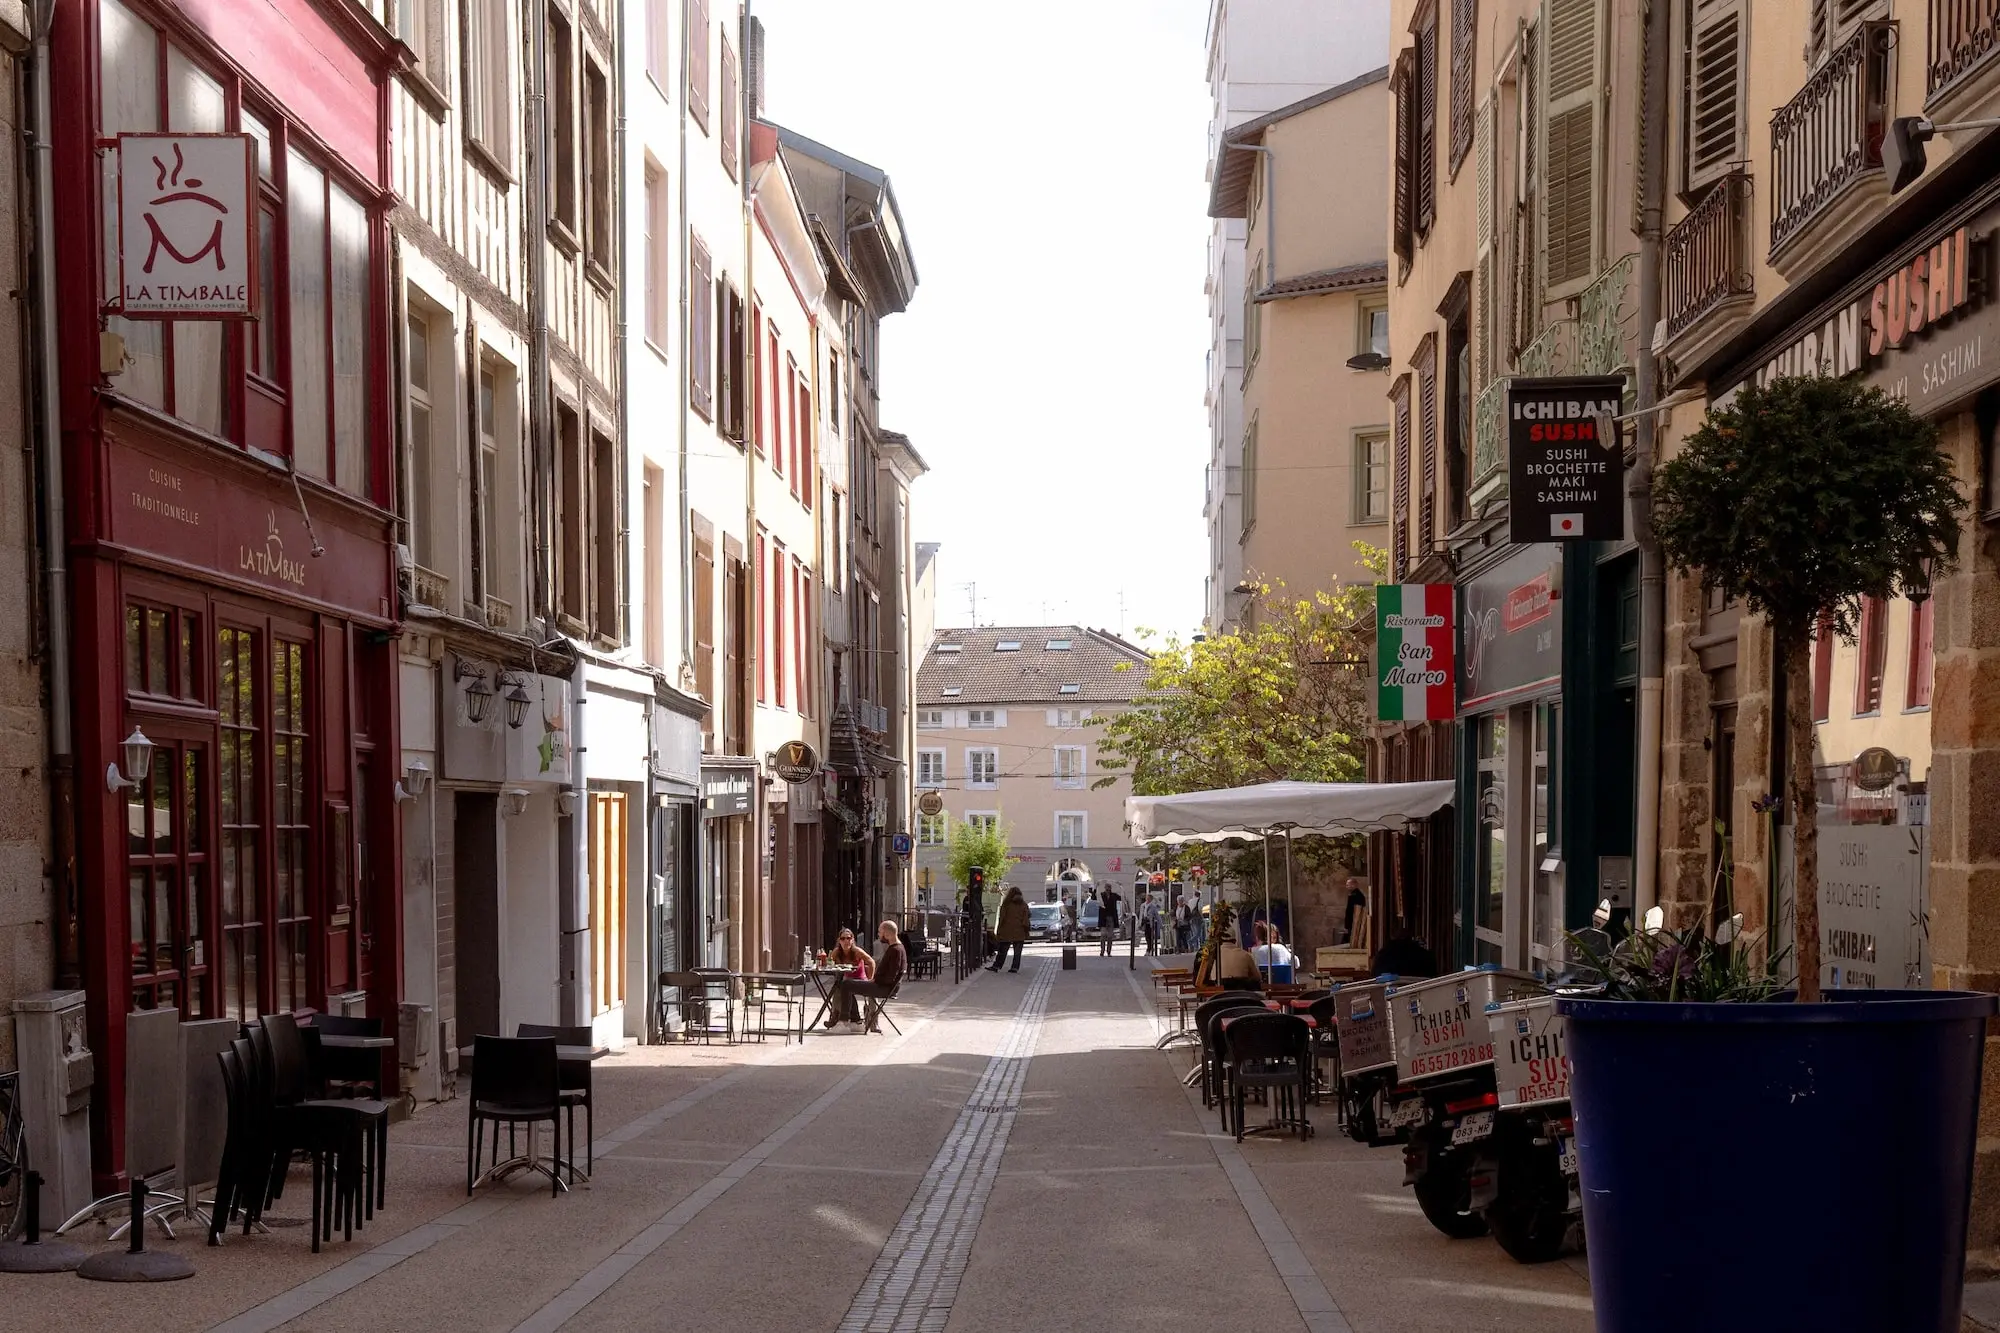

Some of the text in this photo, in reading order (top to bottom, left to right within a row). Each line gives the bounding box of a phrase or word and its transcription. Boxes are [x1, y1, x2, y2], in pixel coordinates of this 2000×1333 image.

[126, 285, 246, 300] LA TIMBALE
[1869, 227, 1970, 356] SUSHI
[1922, 335, 1982, 395] SASHIMI
[1513, 400, 1619, 420] ICHIBAN
[1530, 423, 1600, 442] SUSH
[1546, 449, 1588, 461] SUSHI
[1526, 462, 1607, 475] BROCHETTE
[149, 468, 183, 492] CUISINE
[1549, 476, 1585, 488] MAKI
[1537, 490, 1598, 503] SASHIMI
[131, 492, 200, 526] TRADITIONNELLE
[240, 543, 306, 586] LA TIMBALE
[1385, 614, 1445, 628] Ristorante
[1399, 643, 1432, 660] San
[1383, 667, 1446, 686] Marco
[779, 764, 812, 774] GUINNESS
[1826, 881, 1880, 910] BROCHETTE
[1828, 929, 1876, 963] ICHIBAN
[1414, 1002, 1471, 1032] ICHIBAN
[1424, 1022, 1465, 1045] SUSHI
[1461, 1047, 1476, 1065] 28
[1479, 1043, 1494, 1061] 88
[1510, 1026, 1563, 1064] ICHI
